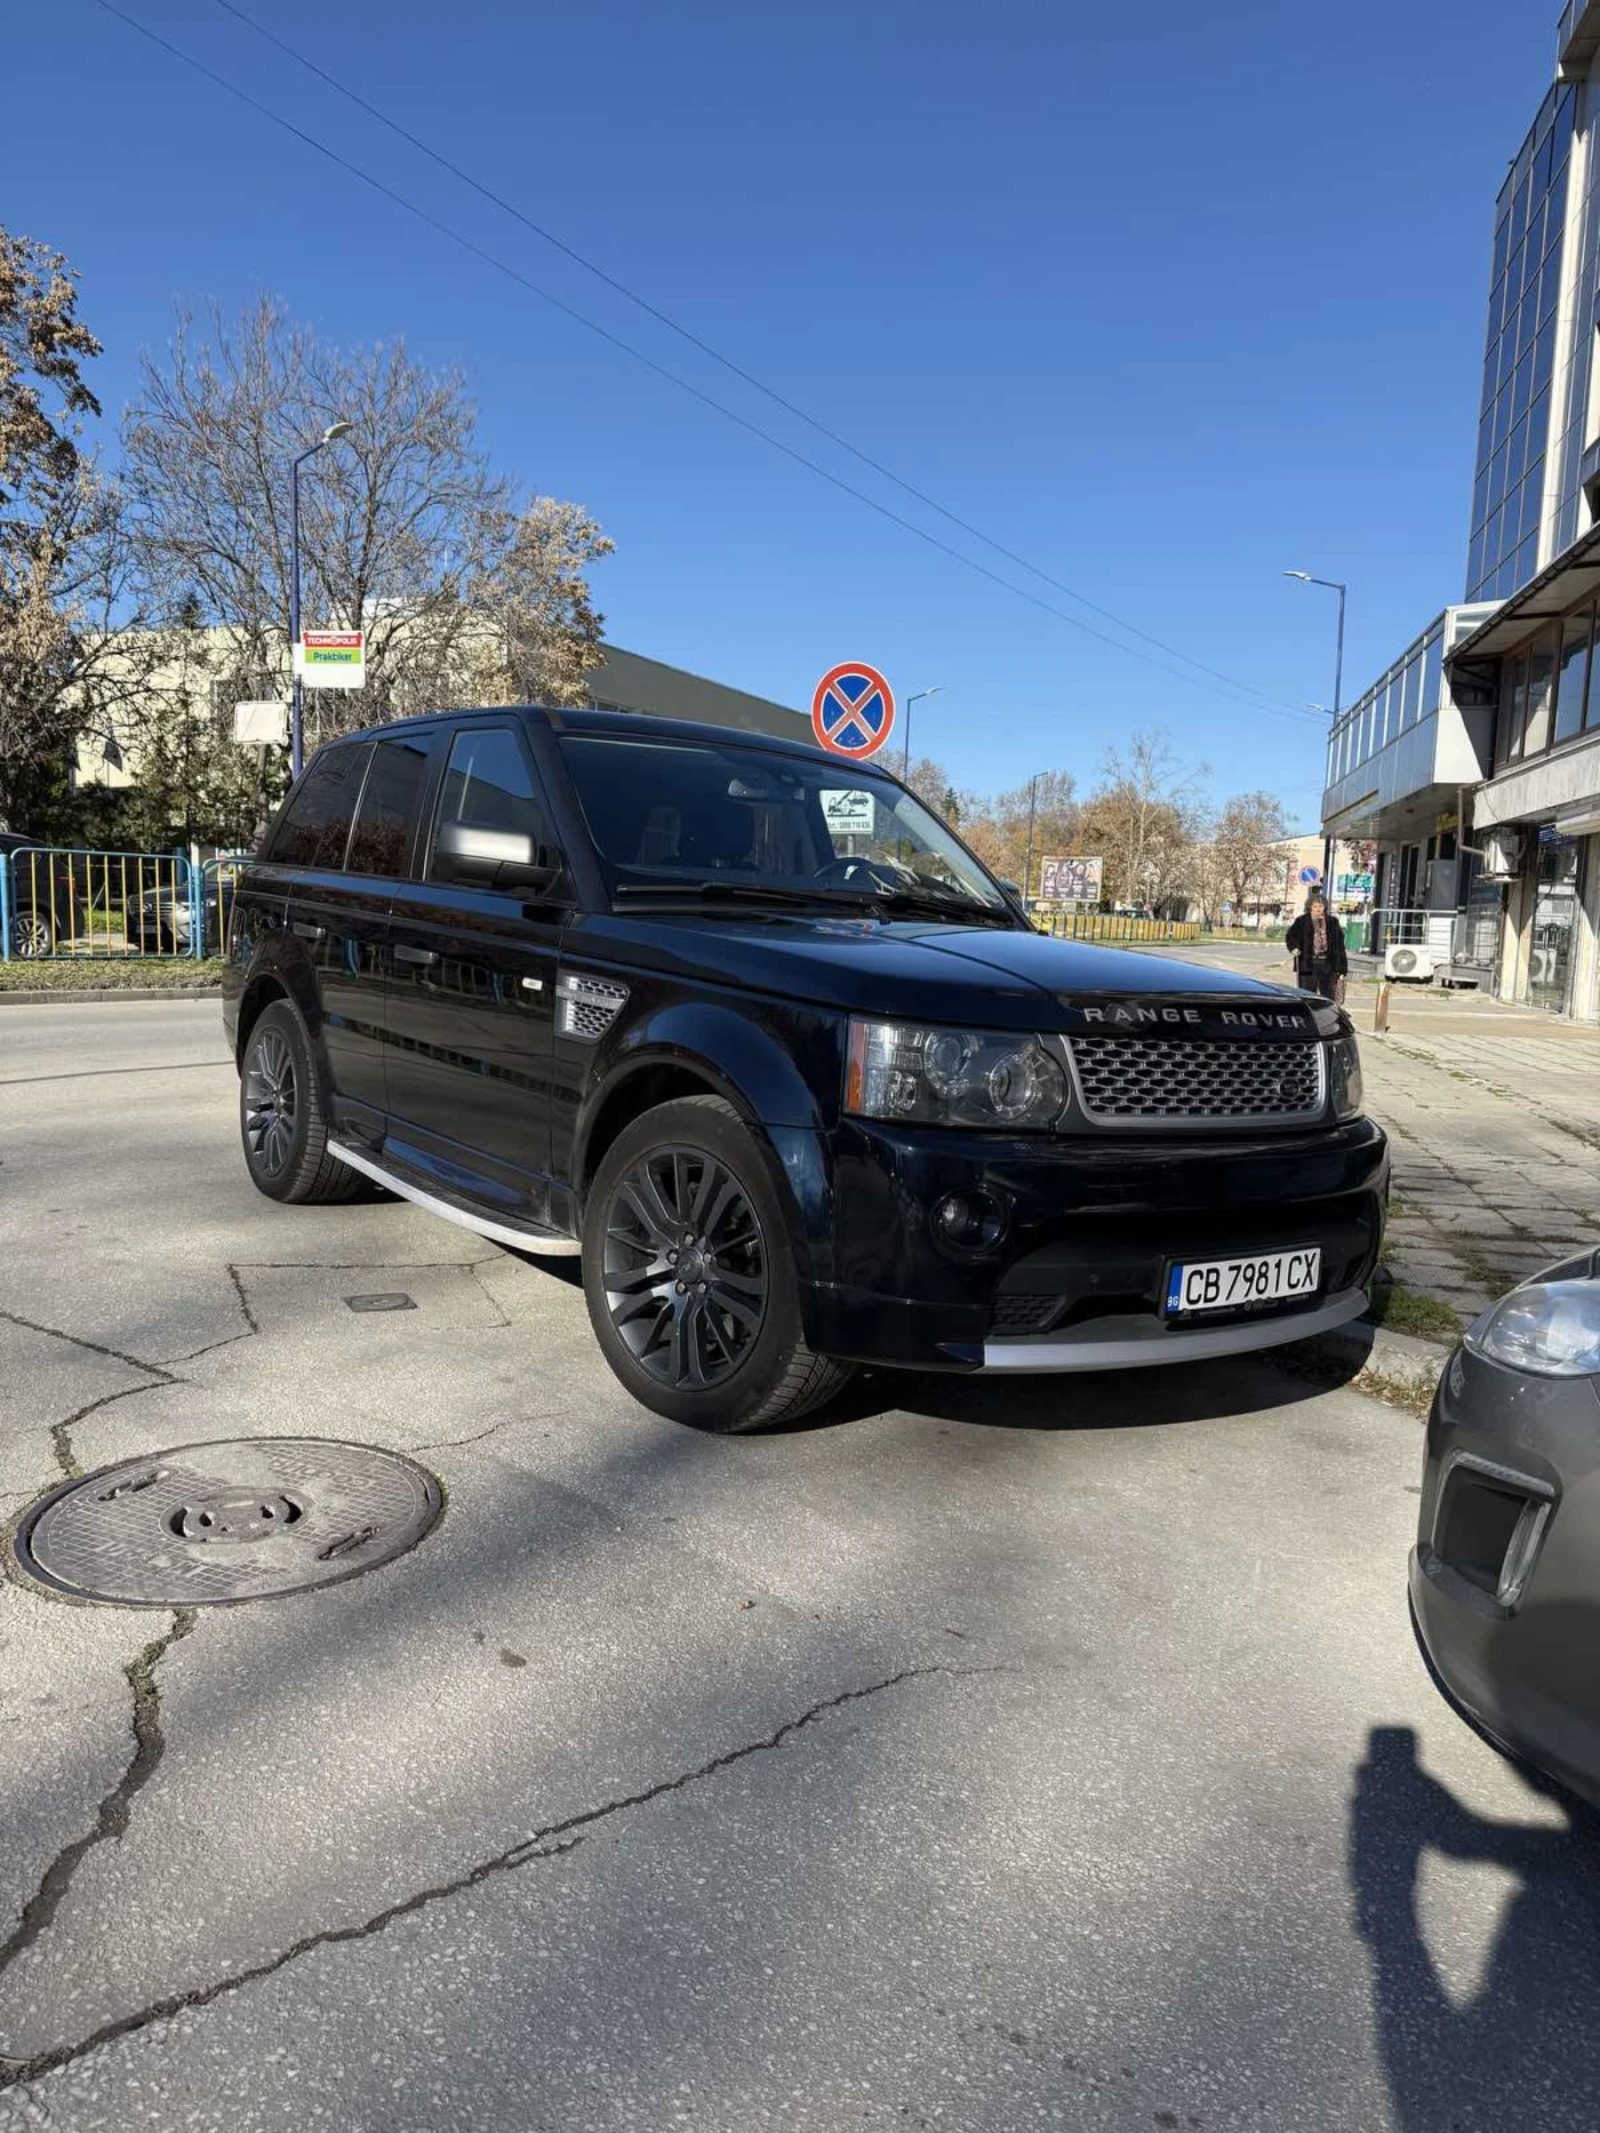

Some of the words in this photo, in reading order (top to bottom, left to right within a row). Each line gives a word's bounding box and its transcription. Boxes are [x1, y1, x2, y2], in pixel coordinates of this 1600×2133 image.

[313, 652, 352, 661] Praktiker
[1083, 1008, 1202, 1023] RANGE
[1221, 1011, 1307, 1028] ROVER
